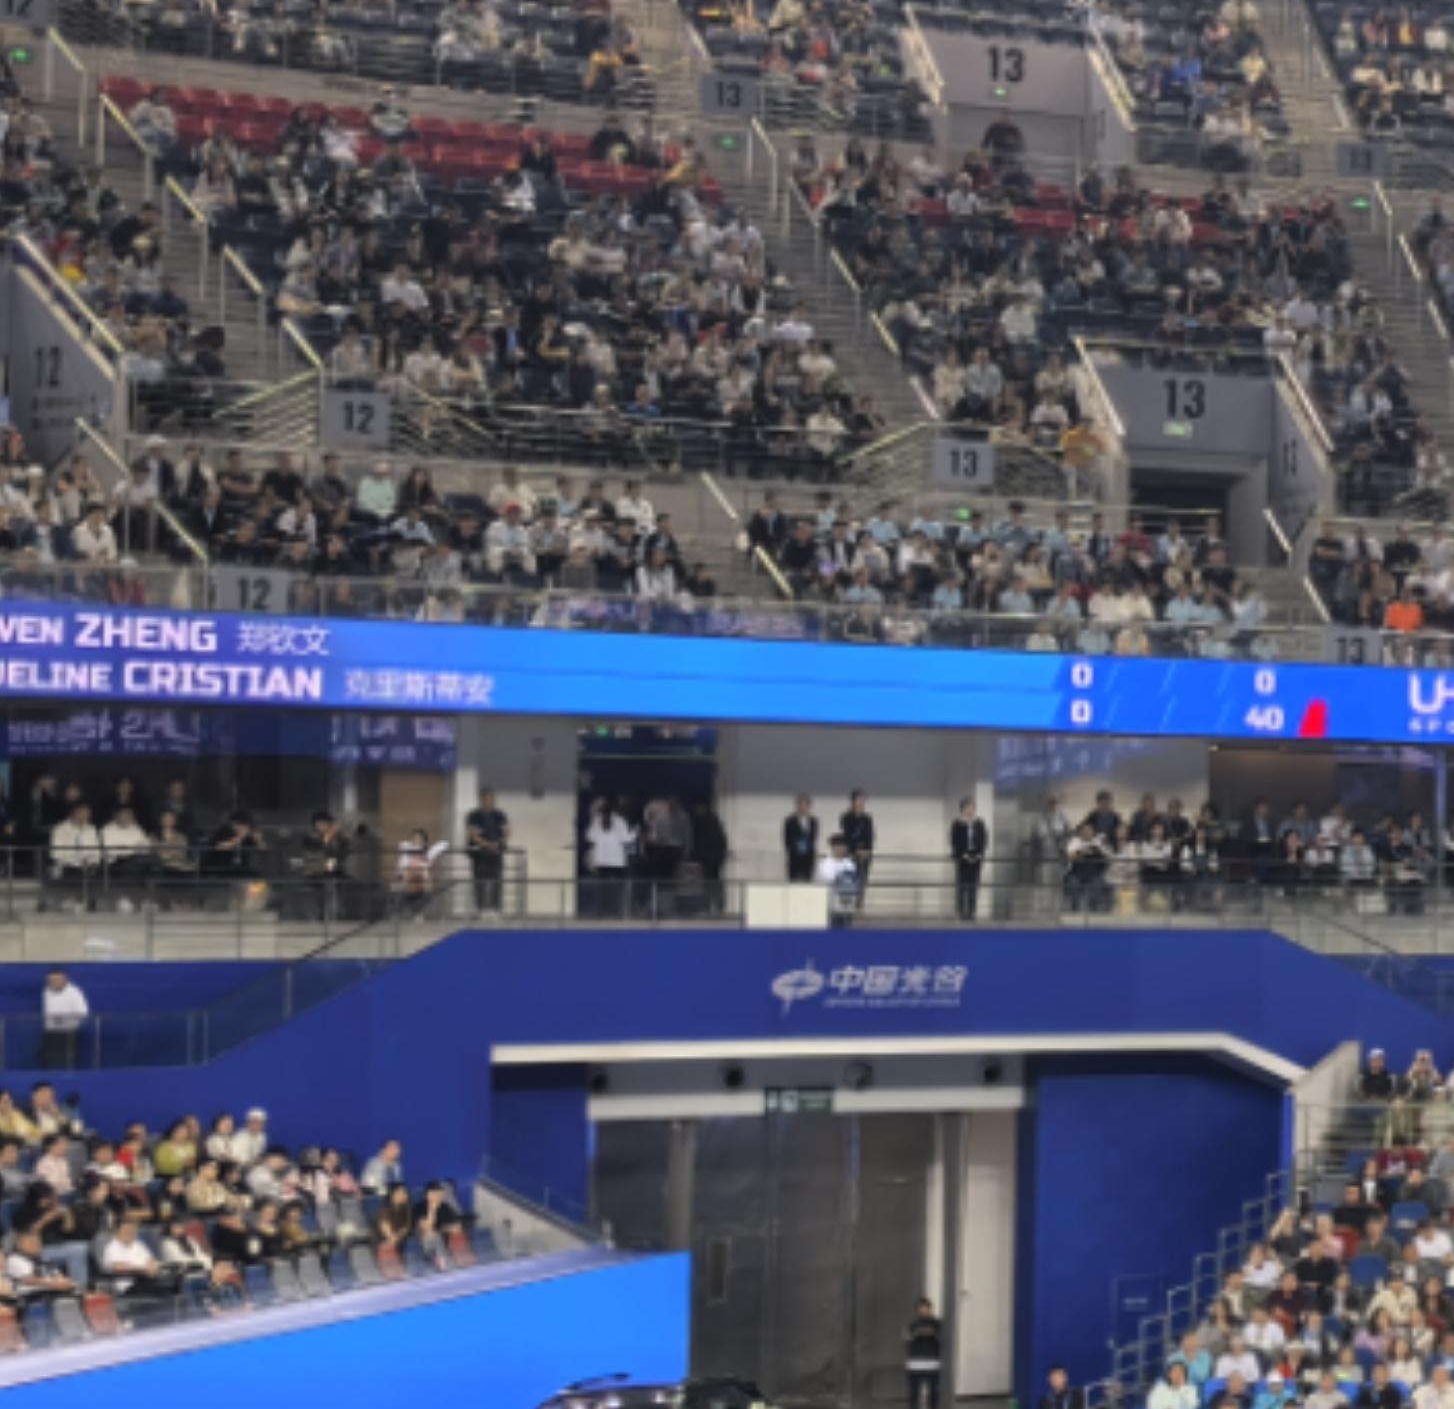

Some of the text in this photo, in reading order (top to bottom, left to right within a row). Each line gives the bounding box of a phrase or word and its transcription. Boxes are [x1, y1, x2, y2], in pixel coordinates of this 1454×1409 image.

[987, 47, 1024, 84] 13
[716, 81, 742, 107] 13
[1163, 378, 1207, 420] 13
[342, 401, 375, 436] 12
[949, 448, 979, 479] 13
[237, 577, 270, 611] 12
[75, 613, 217, 653] ZHENG
[1337, 636, 1365, 665] 13
[0, 660, 112, 691] ELINE
[123, 660, 322, 700] CRISTIAN
[1071, 662, 1277, 696] 0 0
[1071, 699, 1286, 732] 0 40
